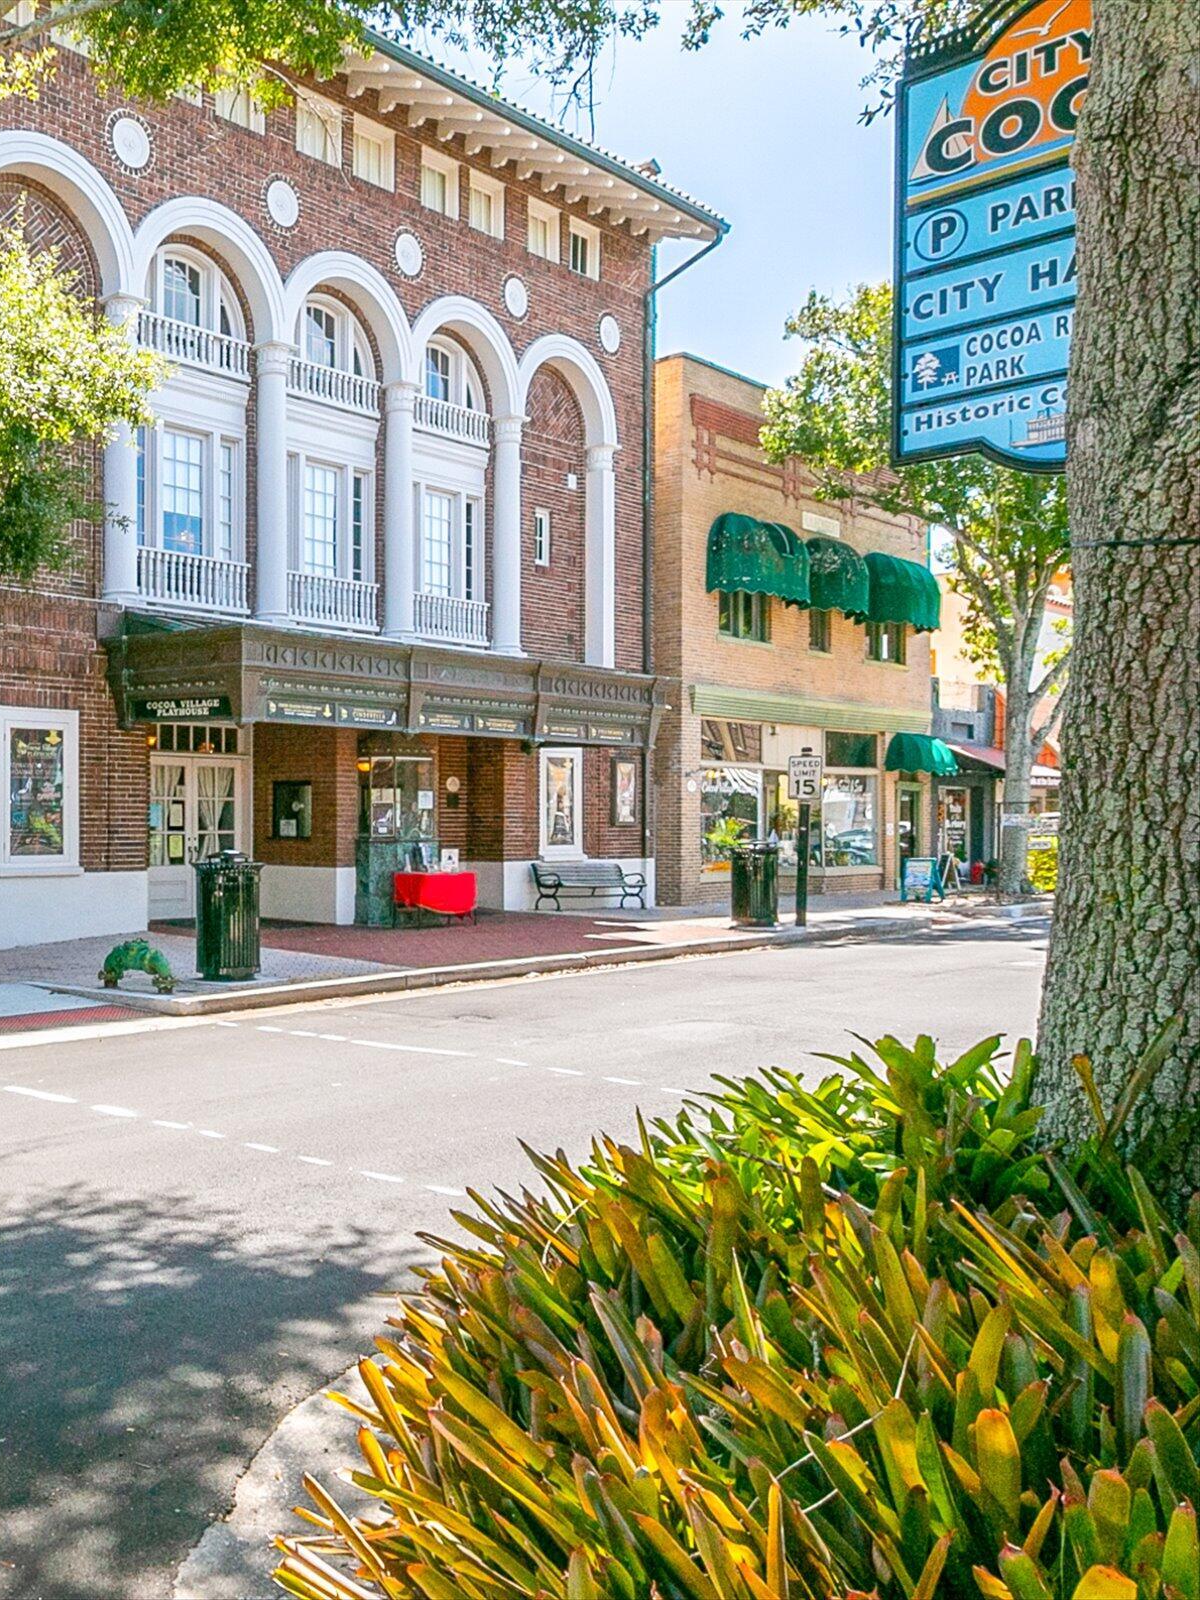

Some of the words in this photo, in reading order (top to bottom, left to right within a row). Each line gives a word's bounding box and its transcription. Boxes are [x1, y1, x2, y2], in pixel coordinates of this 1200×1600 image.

[976, 28, 1092, 96] CITY
[931, 215, 957, 254] P
[912, 272, 1003, 321] CITY
[965, 322, 1042, 358] COCOA
[1055, 313, 1075, 338] R
[965, 354, 1026, 387] PARK
[915, 395, 1031, 432] Historic
[146, 701, 176, 710] COCOA
[180, 699, 220, 708] VILLAGE
[156, 707, 210, 717] PLAYHOUSE
[791, 760, 820, 768] SPEED
[795, 779, 816, 796] 15
